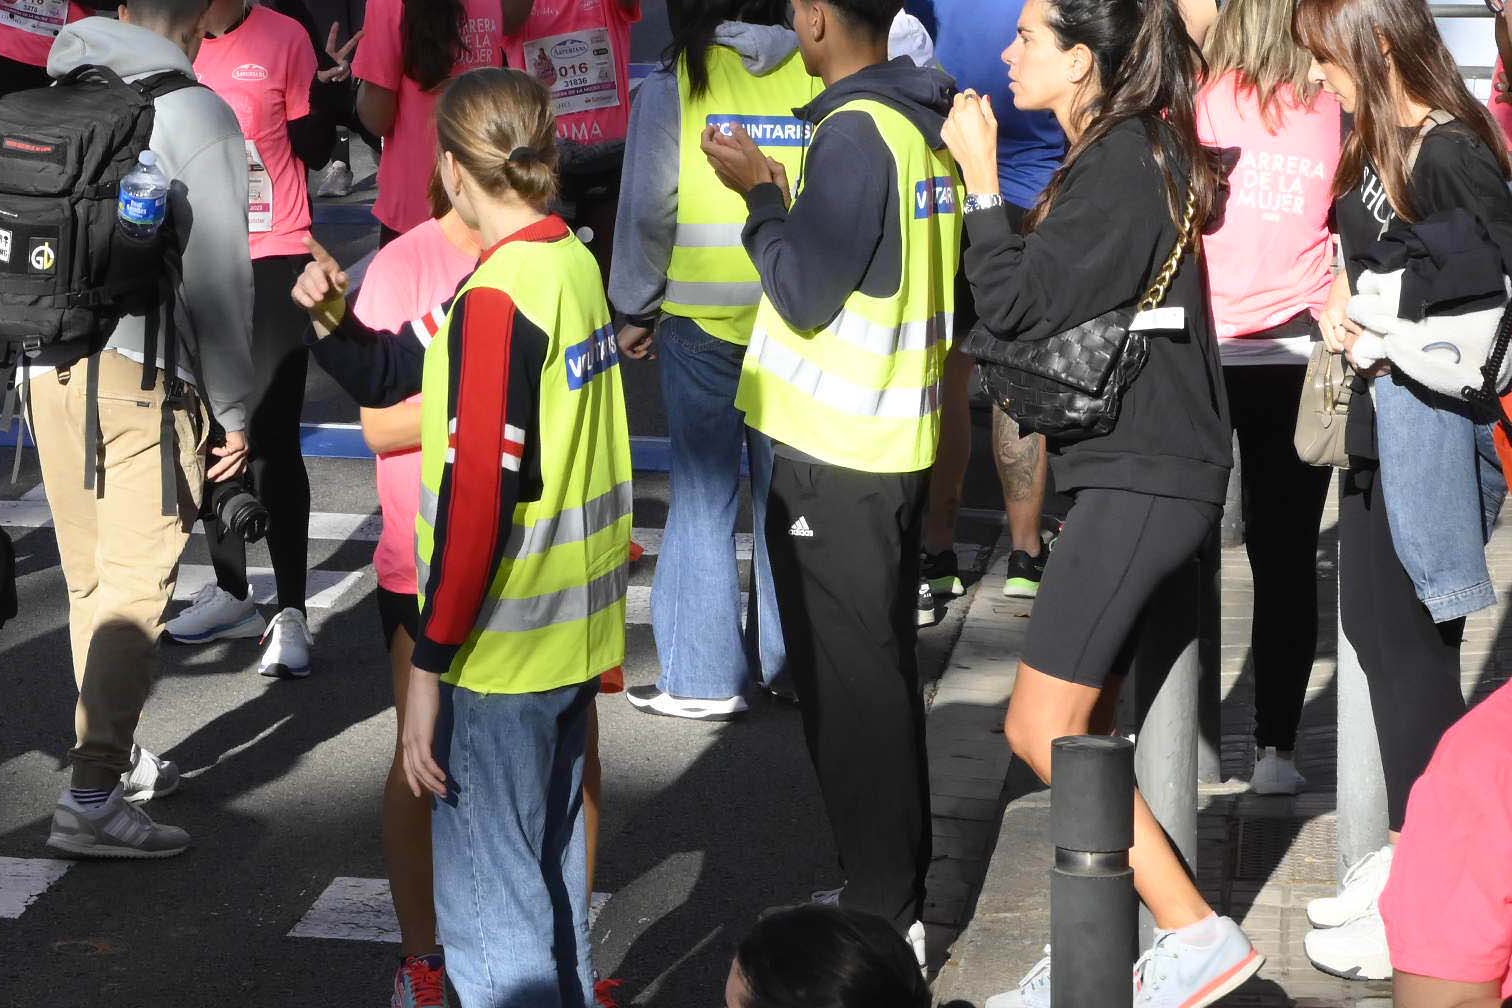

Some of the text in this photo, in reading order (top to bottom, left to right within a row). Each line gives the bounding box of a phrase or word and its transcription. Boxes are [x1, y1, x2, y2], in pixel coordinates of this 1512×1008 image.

[559, 62, 588, 77] 016
[1243, 151, 1326, 182] ARRERA
[1243, 171, 1304, 194] DE LA
[1236, 190, 1305, 215] MUJER
[788, 529, 814, 537] adidas
